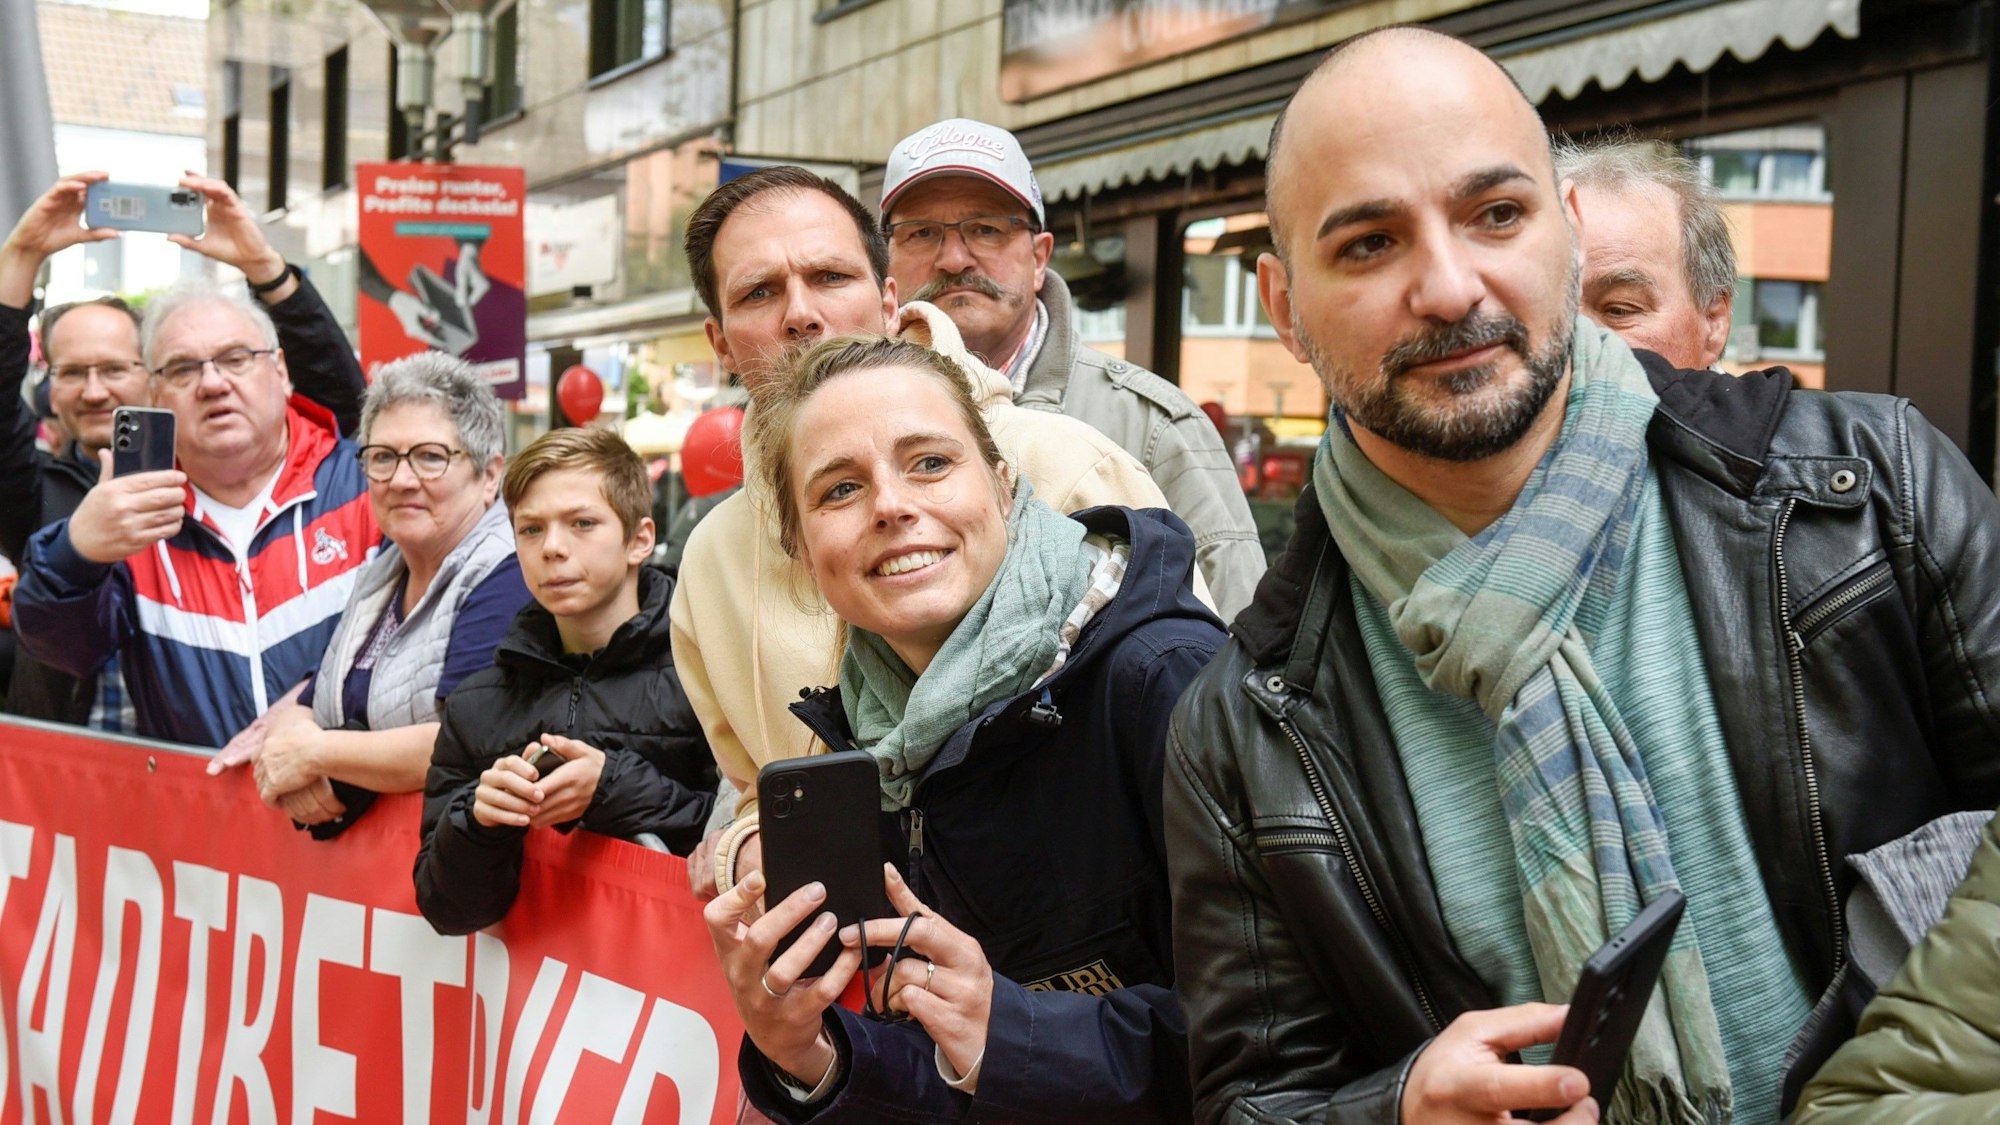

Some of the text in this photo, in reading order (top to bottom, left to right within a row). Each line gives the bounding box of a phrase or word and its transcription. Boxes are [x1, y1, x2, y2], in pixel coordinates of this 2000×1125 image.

[903, 125, 1005, 160] Cologne
[375, 176, 507, 199] Preise runter,
[363, 194, 433, 213] Profite
